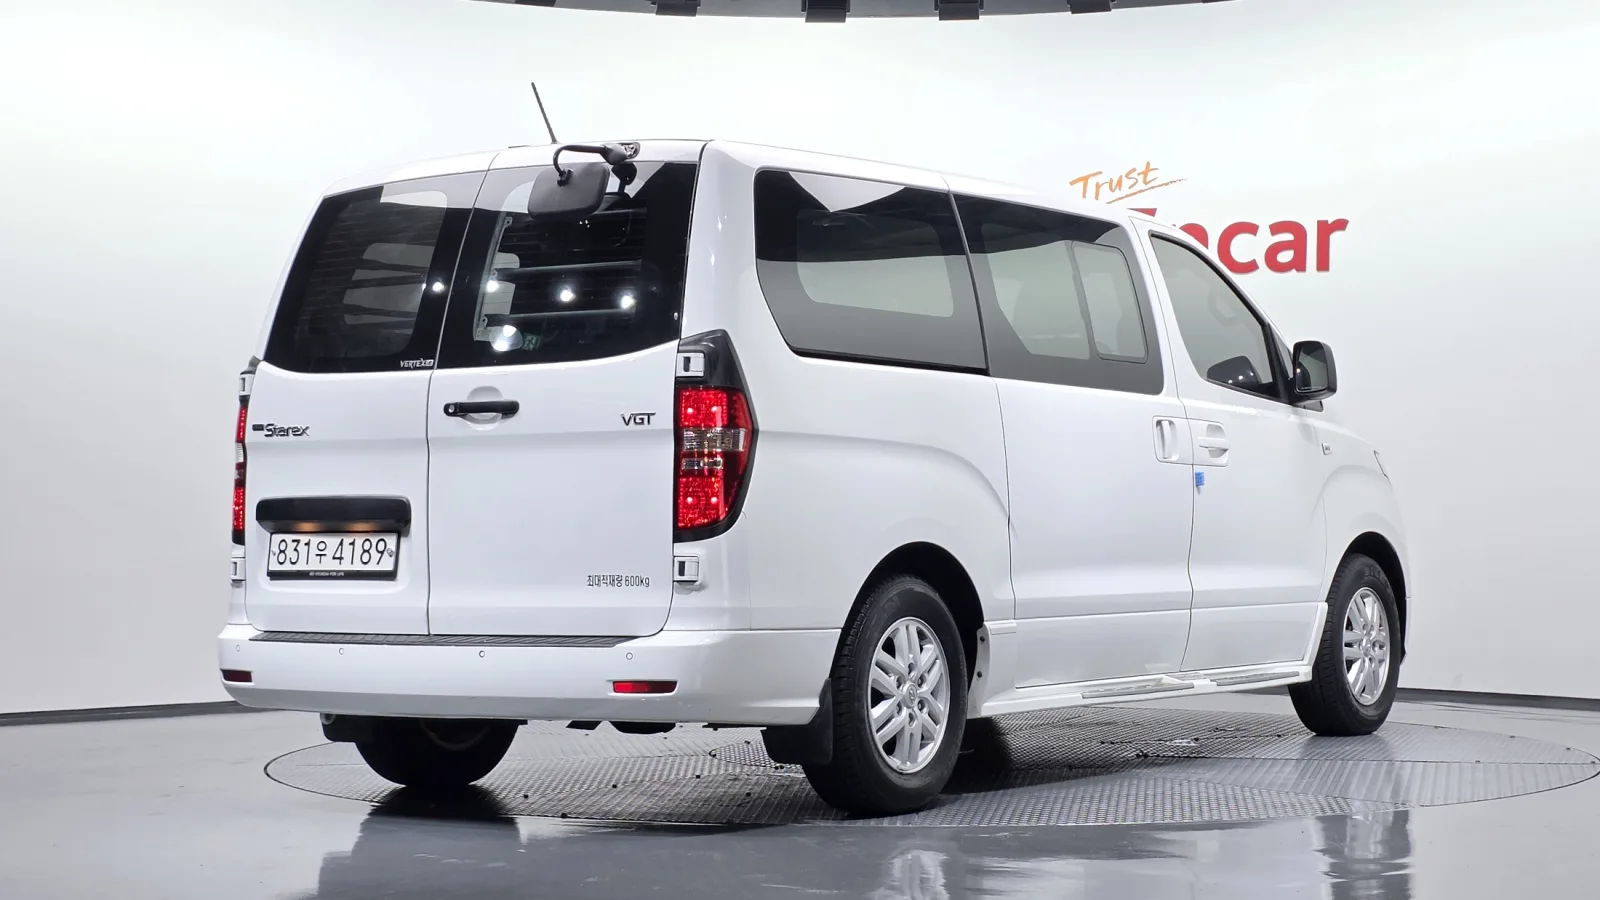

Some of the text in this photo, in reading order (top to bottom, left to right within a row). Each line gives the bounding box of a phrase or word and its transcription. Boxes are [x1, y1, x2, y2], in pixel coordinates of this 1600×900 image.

[1069, 161, 1159, 201] Trust
[1127, 207, 1349, 275] car
[620, 412, 656, 426] VGT
[264, 423, 310, 437] Starex
[587, 574, 650, 588] 최대적재량 600kg
